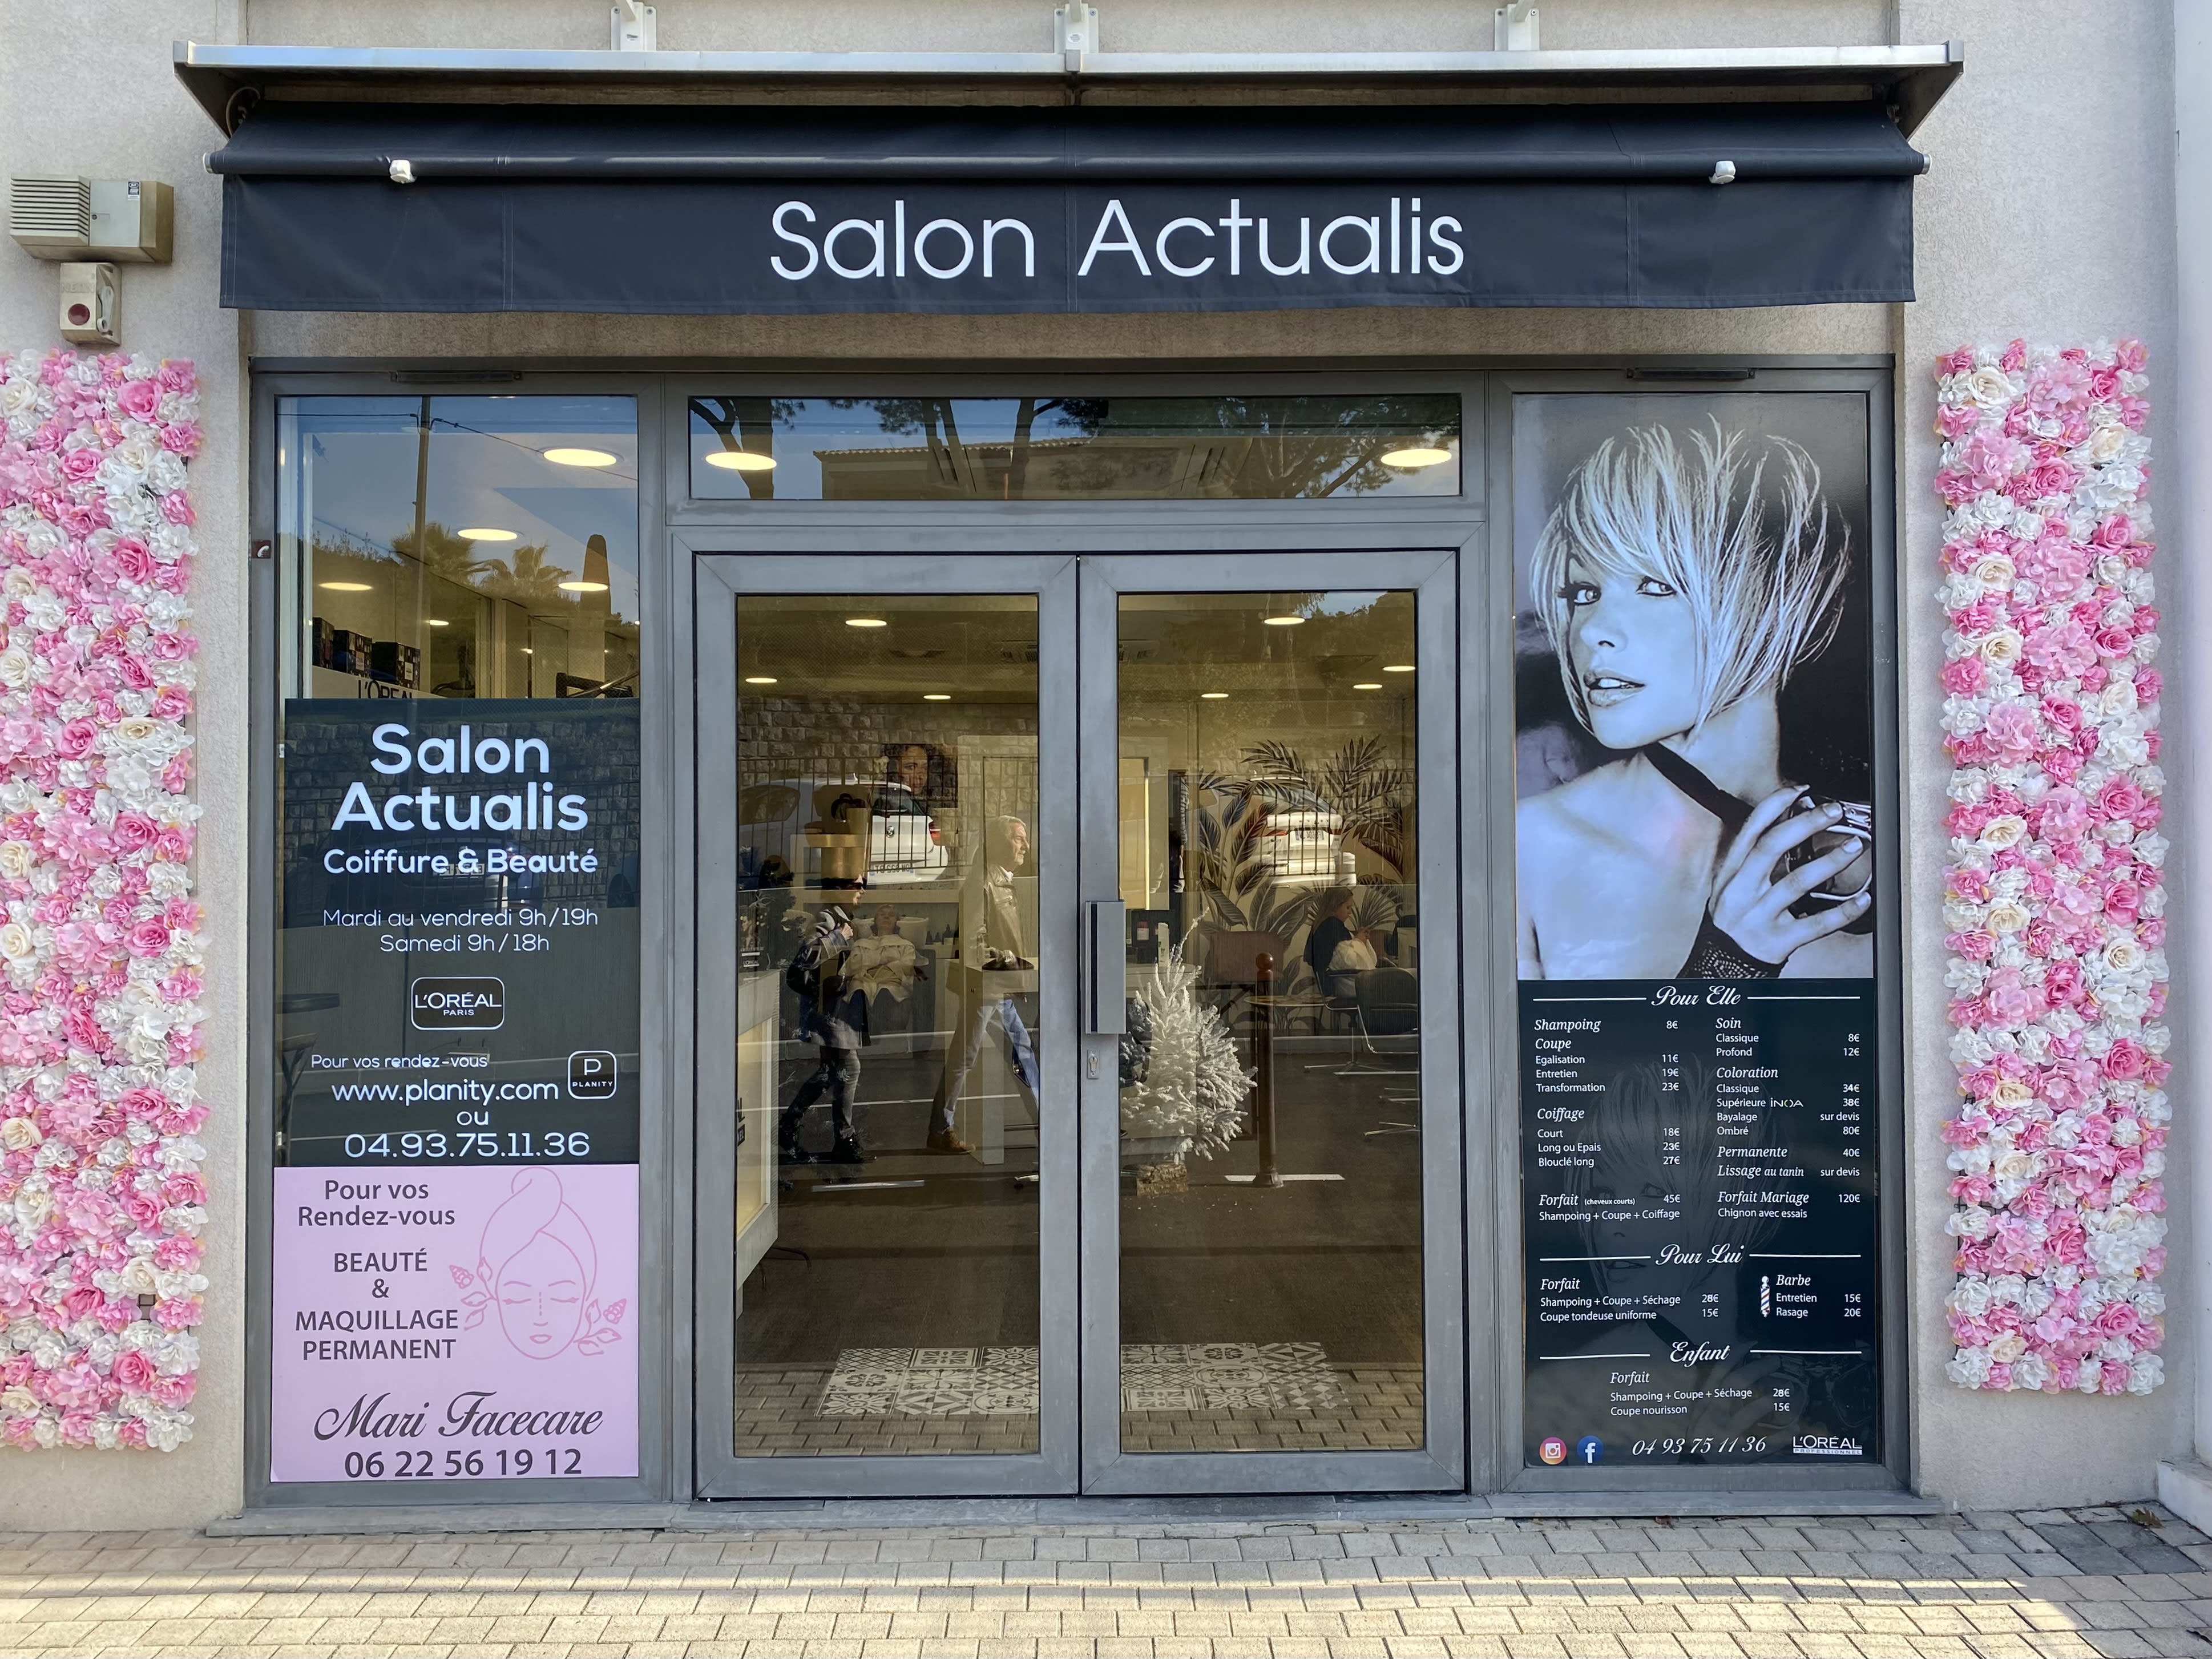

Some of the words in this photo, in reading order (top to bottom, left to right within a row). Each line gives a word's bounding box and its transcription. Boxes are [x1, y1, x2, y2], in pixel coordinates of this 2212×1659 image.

[771, 200, 1034, 280] Salon
[1077, 198, 1463, 276] Actualis
[370, 724, 548, 774] Salon
[332, 782, 588, 830] Actualis
[324, 849, 449, 875] Coiffure
[457, 849, 480, 875] &
[488, 847, 598, 875] Beauté
[324, 910, 381, 926] Mardi
[388, 914, 413, 926] au
[421, 909, 511, 926] vendredi
[381, 935, 460, 951] Samedi
[415, 992, 502, 1010] L'ORÉAL
[1652, 986, 1699, 1006] Pour
[1707, 986, 1741, 1004] Elle
[1535, 1019, 1601, 1033] Shampoing
[1715, 1018, 1741, 1028] Soin
[1536, 1039, 1571, 1052] Coupe
[1716, 1034, 1758, 1044] Classique
[1717, 1047, 1752, 1056] Profond
[312, 1055, 349, 1068] Pour
[353, 1058, 380, 1068] vos
[385, 1054, 488, 1068] rendez-vous
[584, 1059, 601, 1075] P
[1536, 1055, 1585, 1066] Egalisation
[1717, 1067, 1778, 1077] Coloration
[332, 1079, 558, 1106] www.planity.com
[1536, 1083, 1605, 1092] Transformation
[1717, 1084, 1759, 1095] Classique
[1717, 1098, 1766, 1108] Supérieure
[457, 1112, 488, 1125] ou
[1537, 1108, 1584, 1122] Coiffage
[1717, 1112, 1757, 1123] Bayalage
[1836, 1112, 1859, 1120] devis
[1717, 1126, 1748, 1135] Ombré
[345, 1132, 589, 1157] 04.93.75.11.36
[1539, 1144, 1560, 1153] Long
[1578, 1143, 1601, 1153] Epais
[1717, 1147, 1787, 1157] Permanente
[1539, 1157, 1572, 1166] Blouclé
[1574, 1157, 1594, 1168] long
[1717, 1165, 1761, 1178] Lissage
[1779, 1167, 1803, 1176] tanin
[1836, 1167, 1859, 1176] devis
[326, 1180, 381, 1200] Pour
[388, 1184, 428, 1198] vos
[1539, 1194, 1579, 1208] Forfait
[1718, 1191, 1757, 1205] Forfait
[1760, 1192, 1809, 1206] Mariage
[299, 1205, 454, 1226] Rendez-vous
[1540, 1212, 1591, 1222] Shampoing
[1602, 1211, 1631, 1221] Coupe
[1642, 1209, 1680, 1220] Coiffage
[1718, 1208, 1756, 1218] Chignon
[335, 1248, 427, 1272] BEAUTÉ
[1656, 1244, 1702, 1265] Pour
[1707, 1244, 1744, 1263] Lui
[1540, 1278, 1580, 1293] Forfait
[1776, 1274, 1811, 1285] Barbe
[372, 1279, 389, 1298] &
[1541, 1297, 1592, 1308] Shampoing
[1603, 1296, 1632, 1306] Coupe
[1642, 1295, 1680, 1306] Séchage
[1777, 1293, 1817, 1302] Entretien
[1540, 1313, 1569, 1323] Coupe
[1572, 1311, 1613, 1321] tondeuse
[1616, 1310, 1656, 1319] uniforme
[1777, 1307, 1808, 1318] Rasage
[296, 1310, 458, 1333] MAQUILLAGE
[304, 1339, 456, 1360] PERMANENT
[1670, 1342, 1730, 1367] Enfant
[1610, 1371, 1649, 1386] Forfait
[1611, 1392, 1662, 1402] Shampoing
[1674, 1391, 1703, 1400] Coupe
[1714, 1388, 1752, 1399] Séchage
[1773, 1388, 1790, 1397] 28€
[314, 1393, 429, 1440] Mari
[438, 1391, 603, 1436] Facecare
[1611, 1407, 1640, 1417] Coupe
[1643, 1406, 1687, 1414] nourisson
[1633, 1439, 1657, 1455] 04
[1662, 1439, 1684, 1454] 93
[1691, 1438, 1713, 1453] 75
[1719, 1438, 1738, 1452] 11
[1742, 1436, 1766, 1452] 36
[1792, 1434, 1863, 1450] L'ORÉAL
[345, 1451, 384, 1478] 06
[395, 1451, 433, 1476] 22
[445, 1450, 483, 1476] 56
[497, 1450, 532, 1475] 19
[546, 1449, 581, 1474] 12
